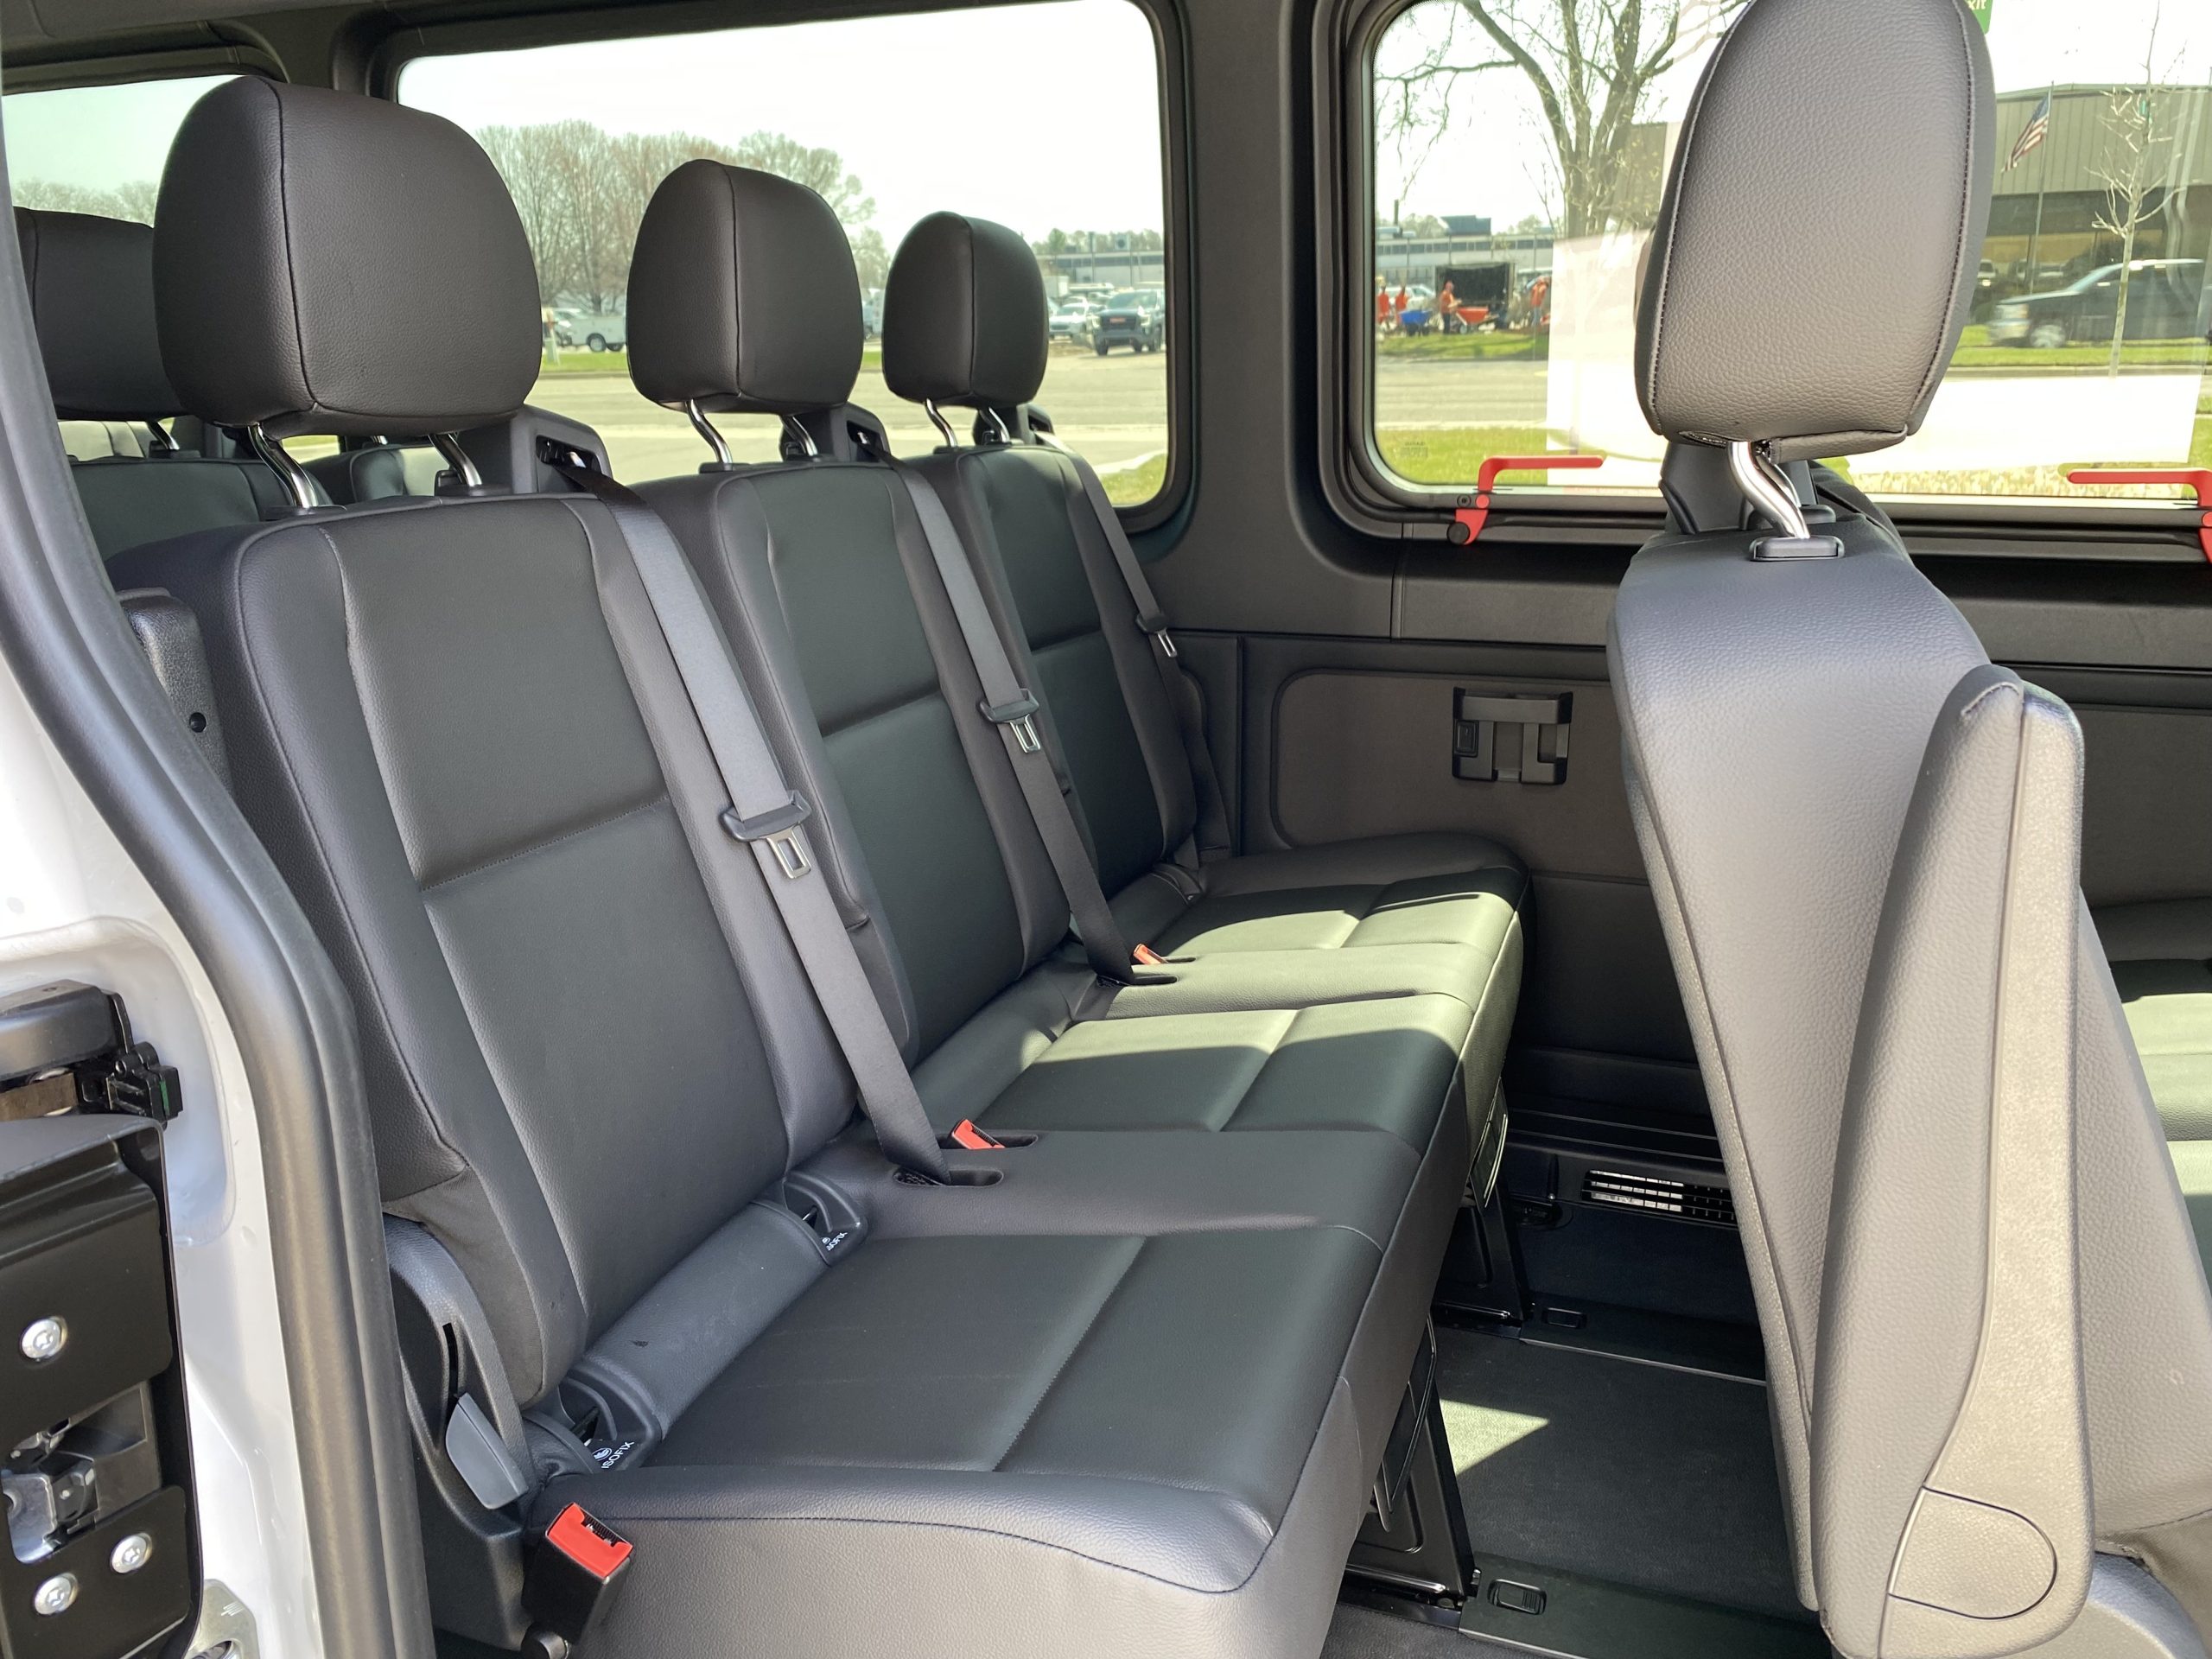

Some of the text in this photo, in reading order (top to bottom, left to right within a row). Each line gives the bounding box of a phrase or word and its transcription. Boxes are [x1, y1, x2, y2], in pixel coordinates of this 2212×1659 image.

[1965, 0, 1986, 10] xit
[826, 1232, 848, 1250] ISOFIX
[601, 1441, 635, 1468] ISOFIX
